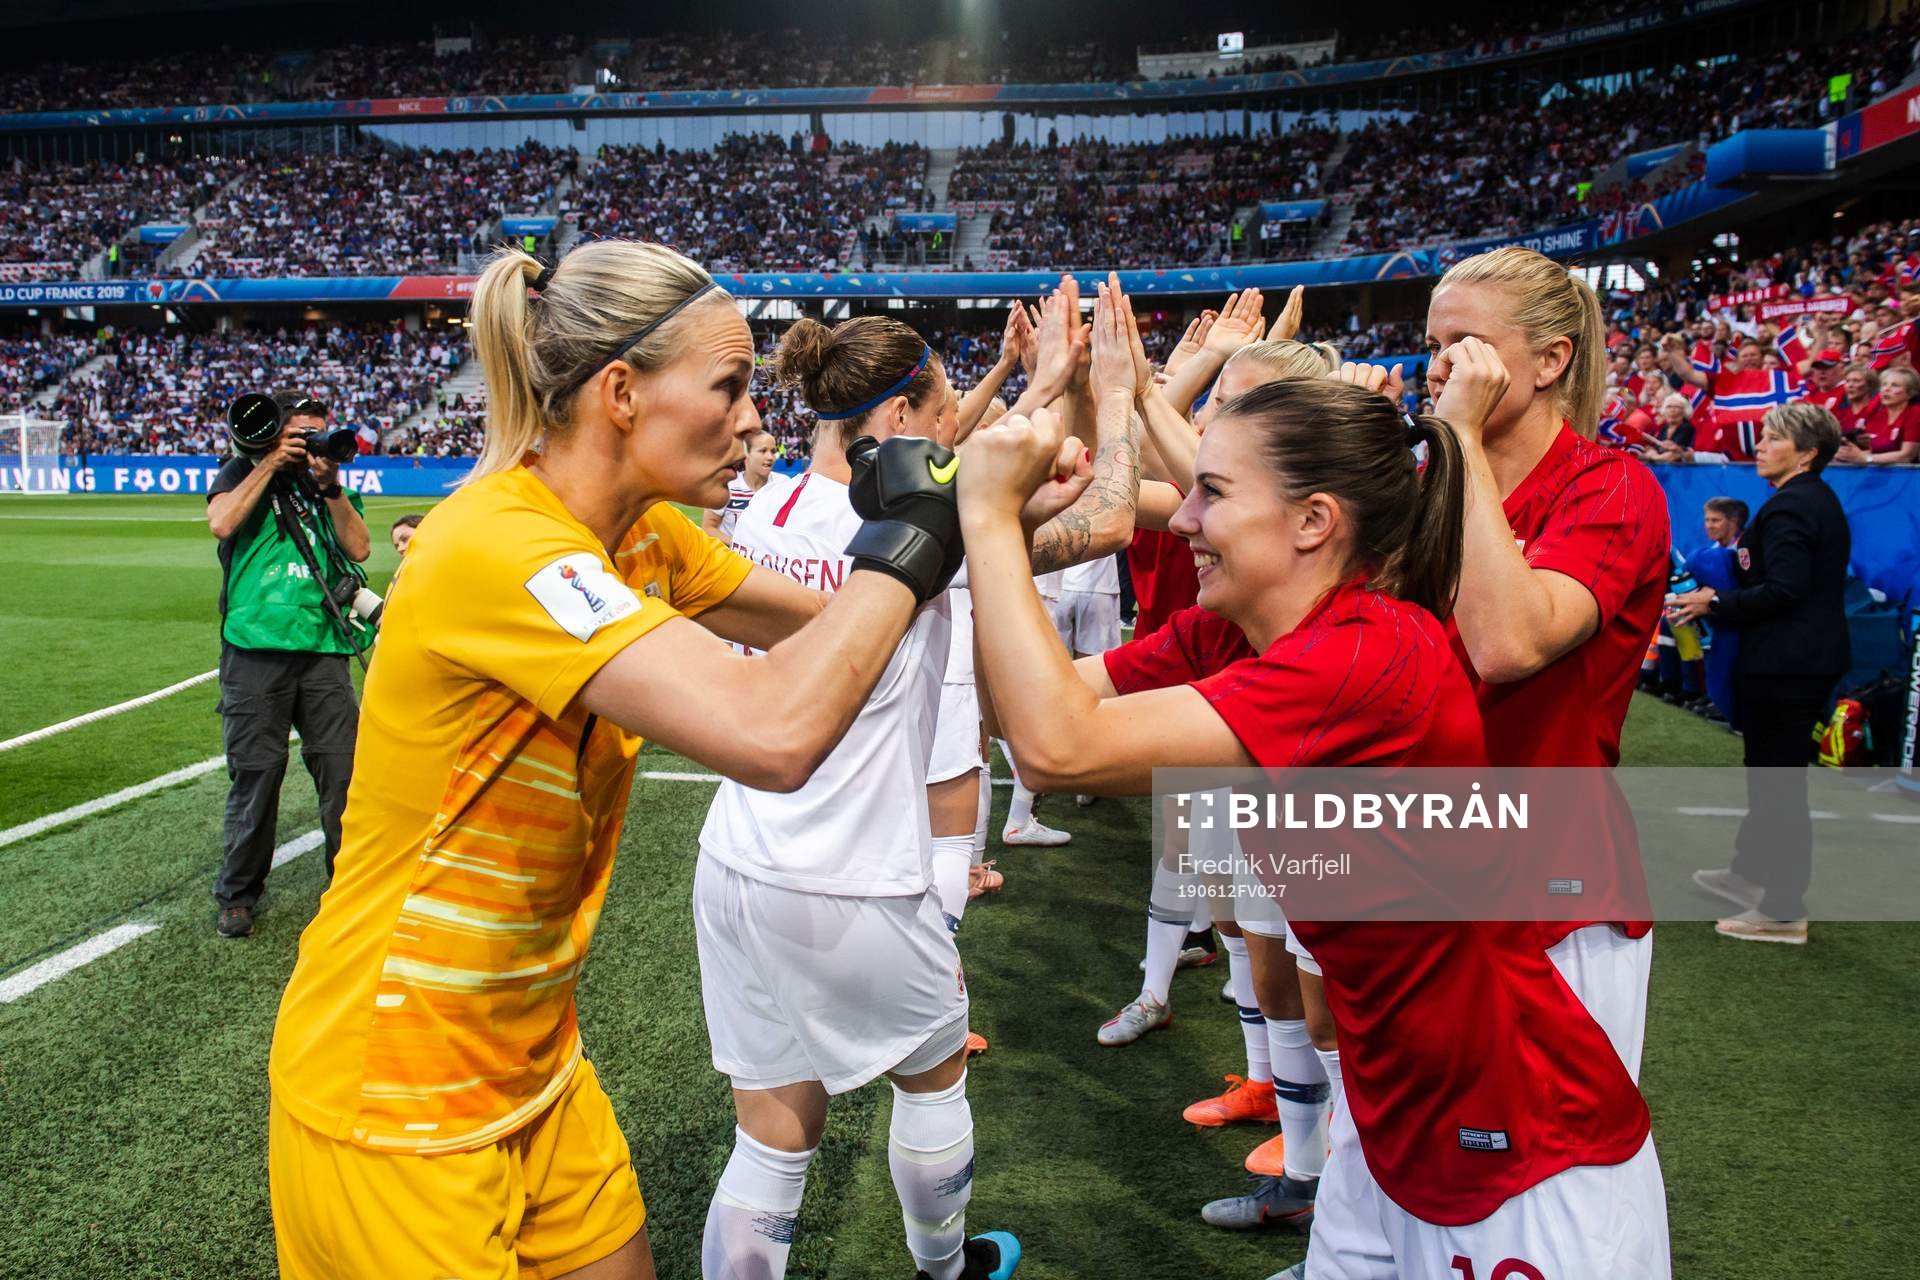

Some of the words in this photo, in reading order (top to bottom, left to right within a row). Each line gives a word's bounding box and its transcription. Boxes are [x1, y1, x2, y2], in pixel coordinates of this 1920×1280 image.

[1543, 232, 1583, 253] SHINE
[16, 287, 42, 300] CUP
[45, 286, 95, 300] FRANCE
[97, 286, 125, 299] 2019
